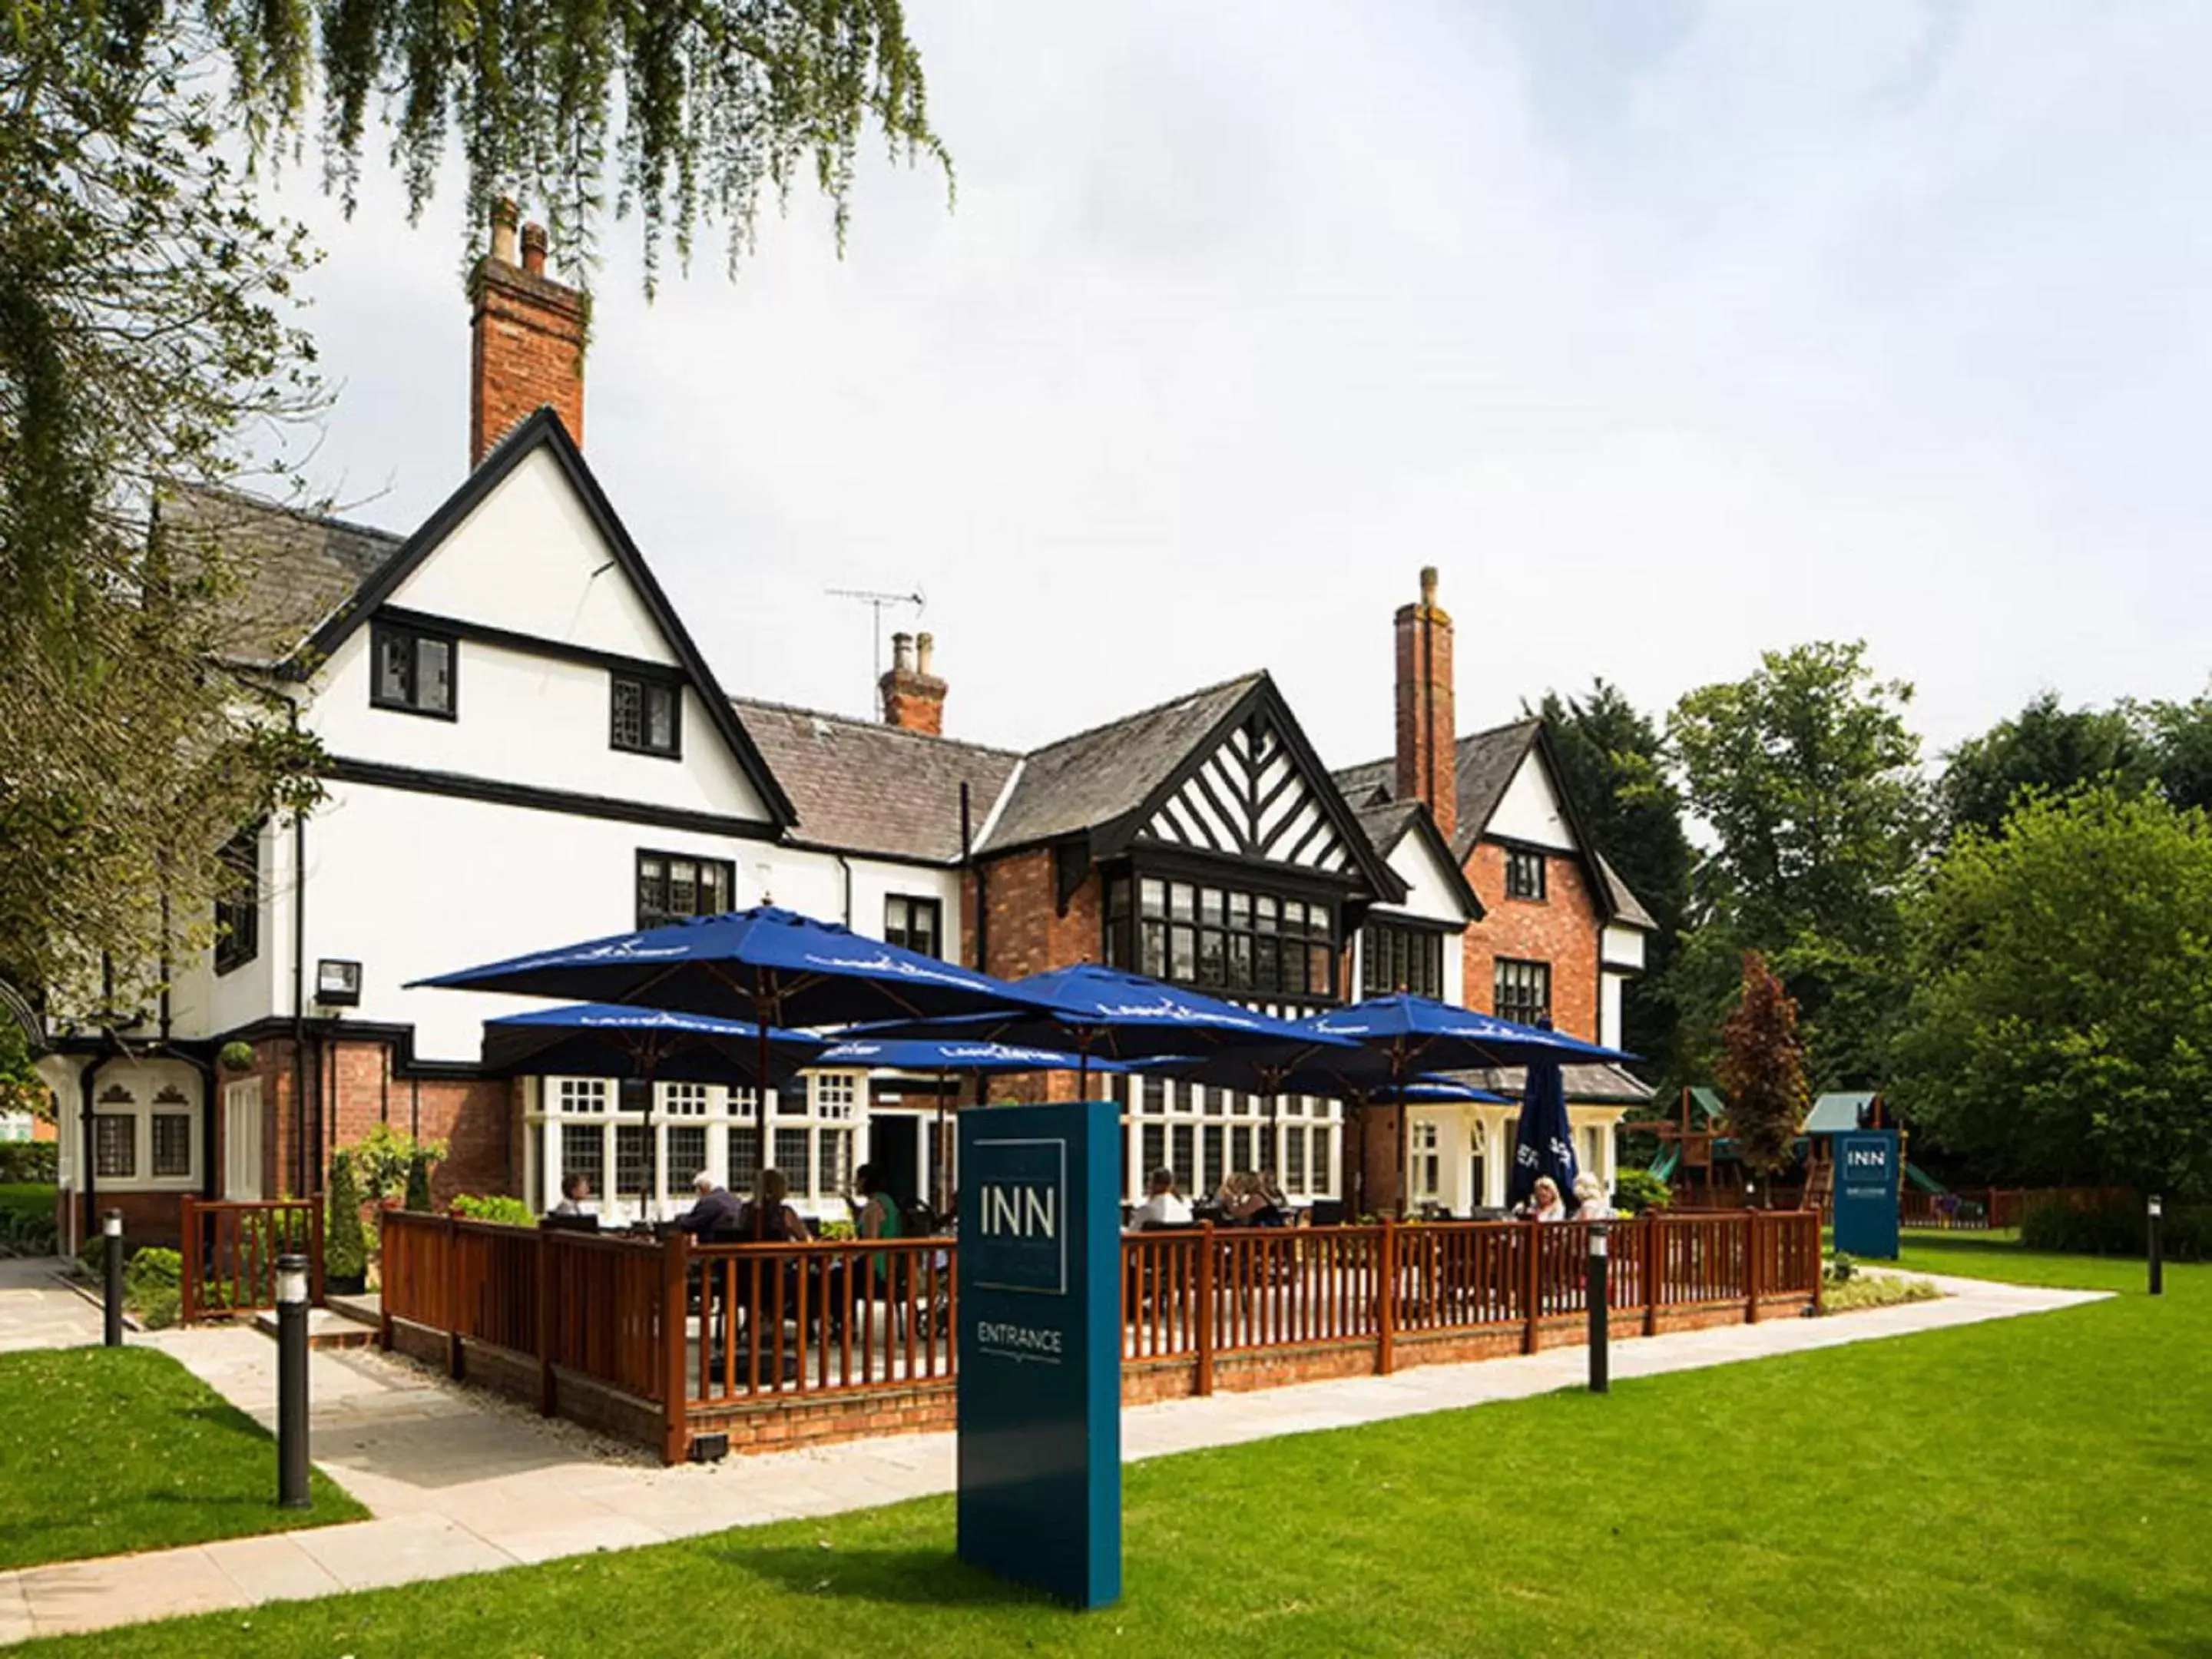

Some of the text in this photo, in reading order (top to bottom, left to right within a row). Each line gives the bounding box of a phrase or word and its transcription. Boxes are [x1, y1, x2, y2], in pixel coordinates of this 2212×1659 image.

[1847, 1150, 1885, 1166] INN
[981, 1185, 1055, 1239] INN
[978, 1321, 1061, 1353] ENTRANCE
